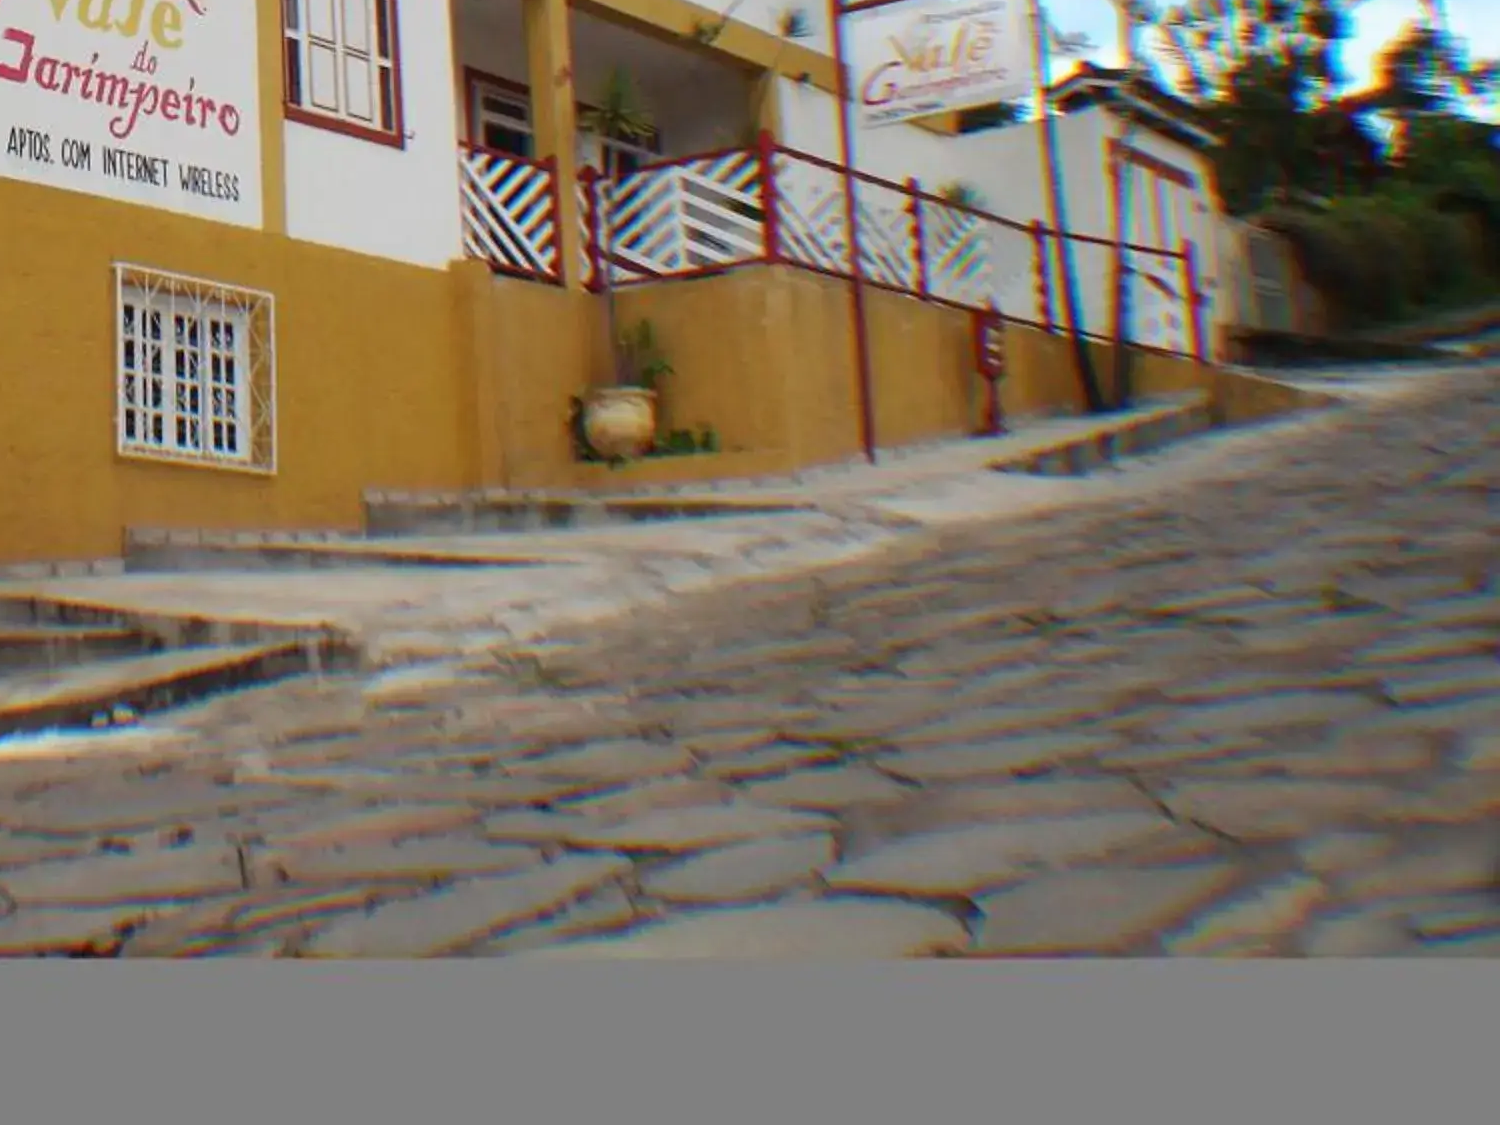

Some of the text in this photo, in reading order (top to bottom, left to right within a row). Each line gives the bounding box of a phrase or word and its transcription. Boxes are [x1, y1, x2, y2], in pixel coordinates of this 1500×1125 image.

[130, 40, 158, 74] do
[7, 126, 240, 202] APTOS. COM INTERNET WIRELESS
